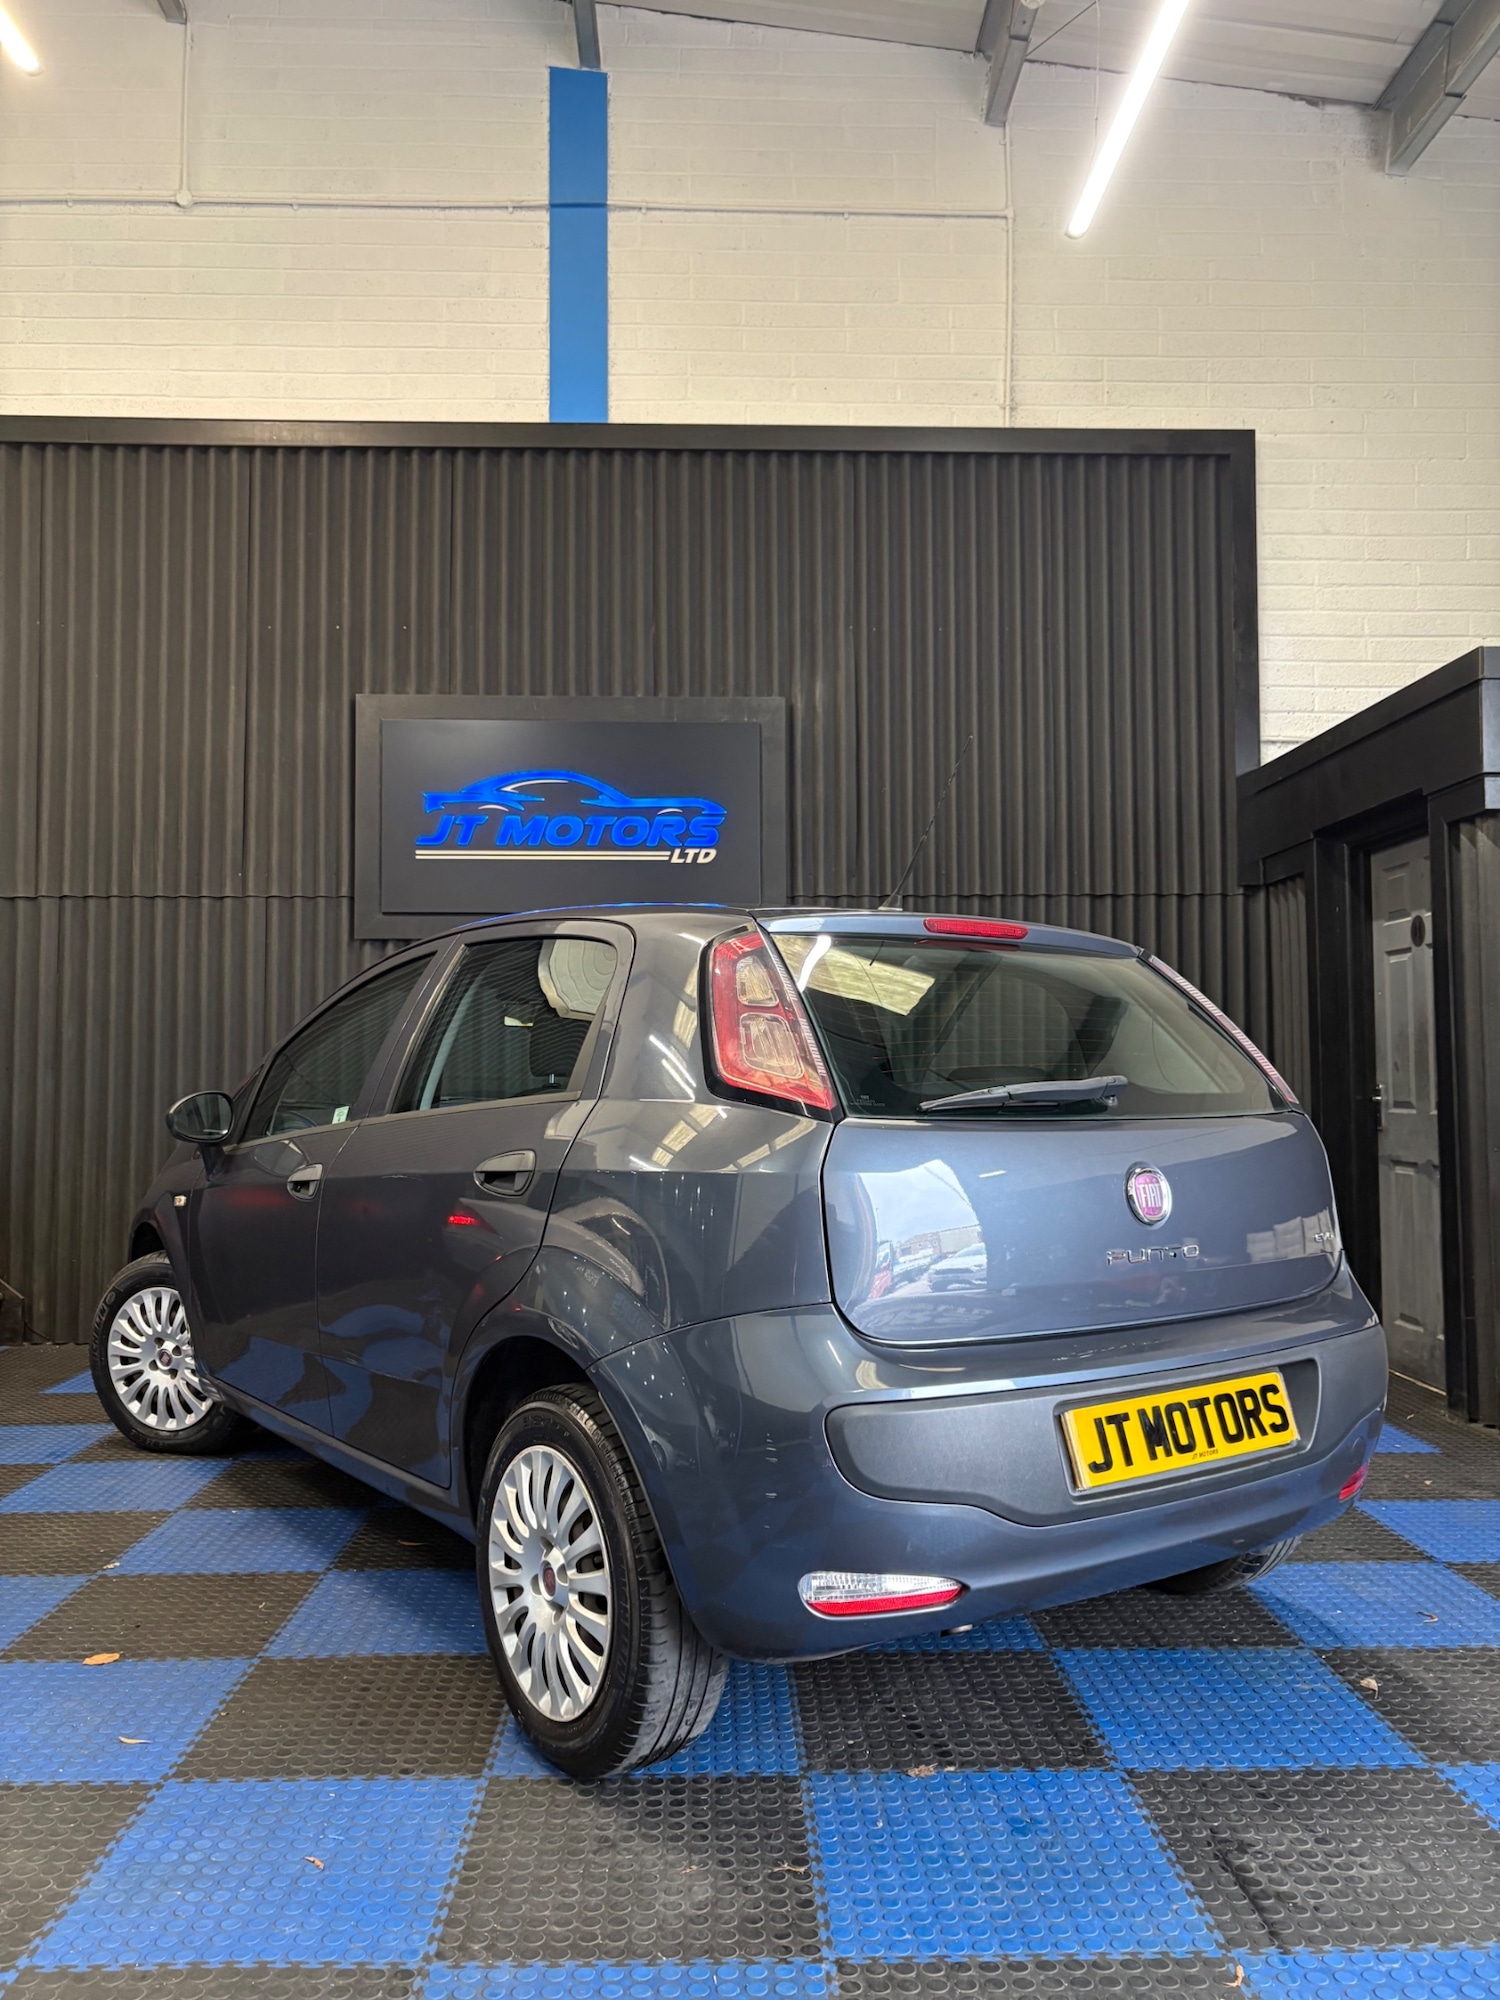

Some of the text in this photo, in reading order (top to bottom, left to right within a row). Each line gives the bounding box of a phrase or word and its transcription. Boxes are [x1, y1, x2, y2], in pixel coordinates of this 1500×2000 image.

[415, 815, 725, 847] JT MOTORS
[670, 848, 717, 864] LTD
[1138, 1183, 1162, 1208] FIAT
[1106, 1244, 1200, 1266] PUNTO
[1087, 1383, 1290, 1474] JT MOTORS
